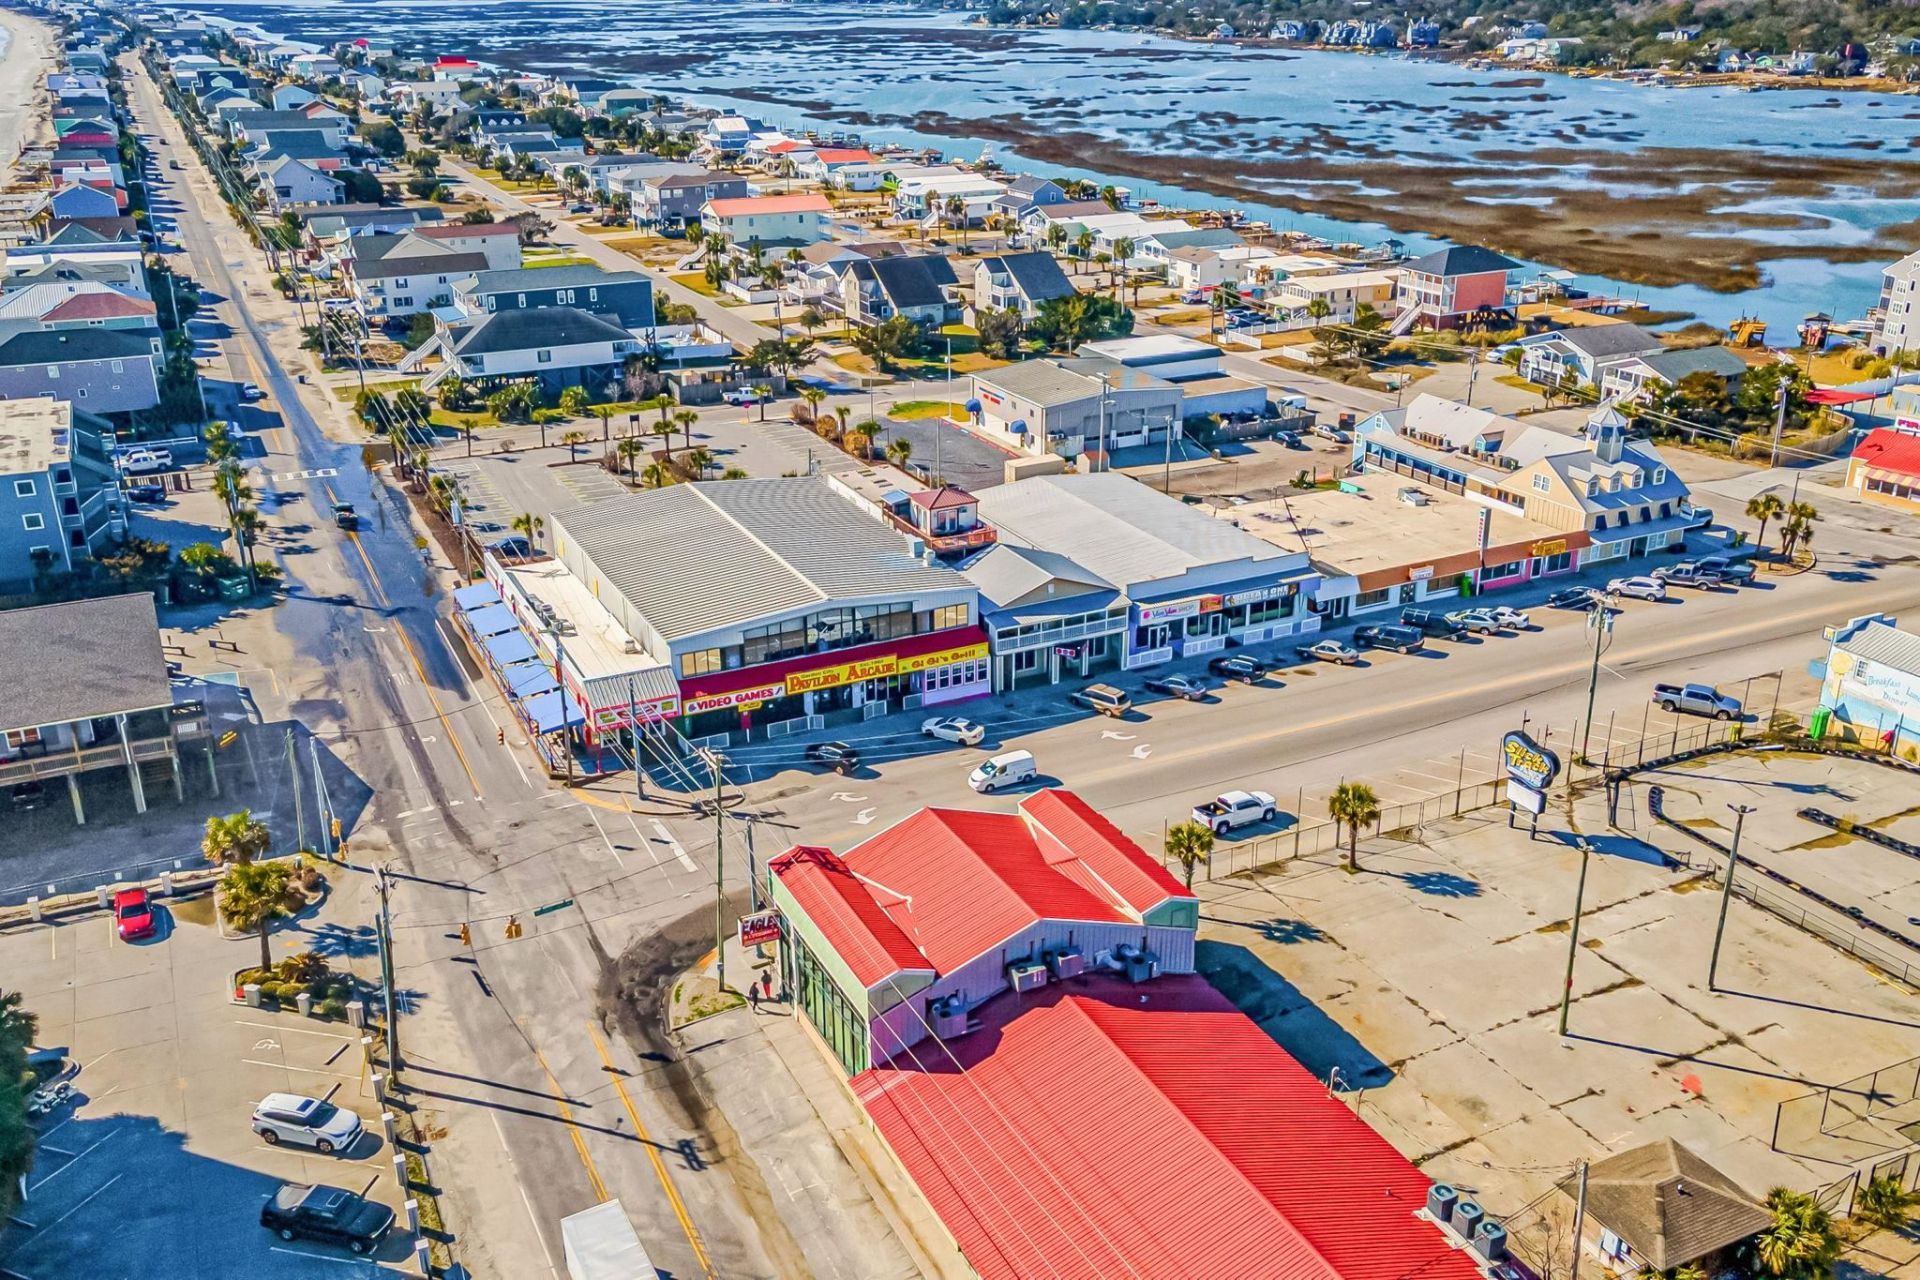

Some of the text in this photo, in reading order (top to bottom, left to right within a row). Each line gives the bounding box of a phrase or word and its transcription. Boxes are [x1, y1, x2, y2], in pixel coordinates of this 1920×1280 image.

[845, 663, 895, 680] ARCADE
[697, 696, 732, 710] VIDEO
[735, 688, 774, 703] GAMES
[1505, 741, 1543, 763] Slick
[1510, 753, 1550, 775] Track
